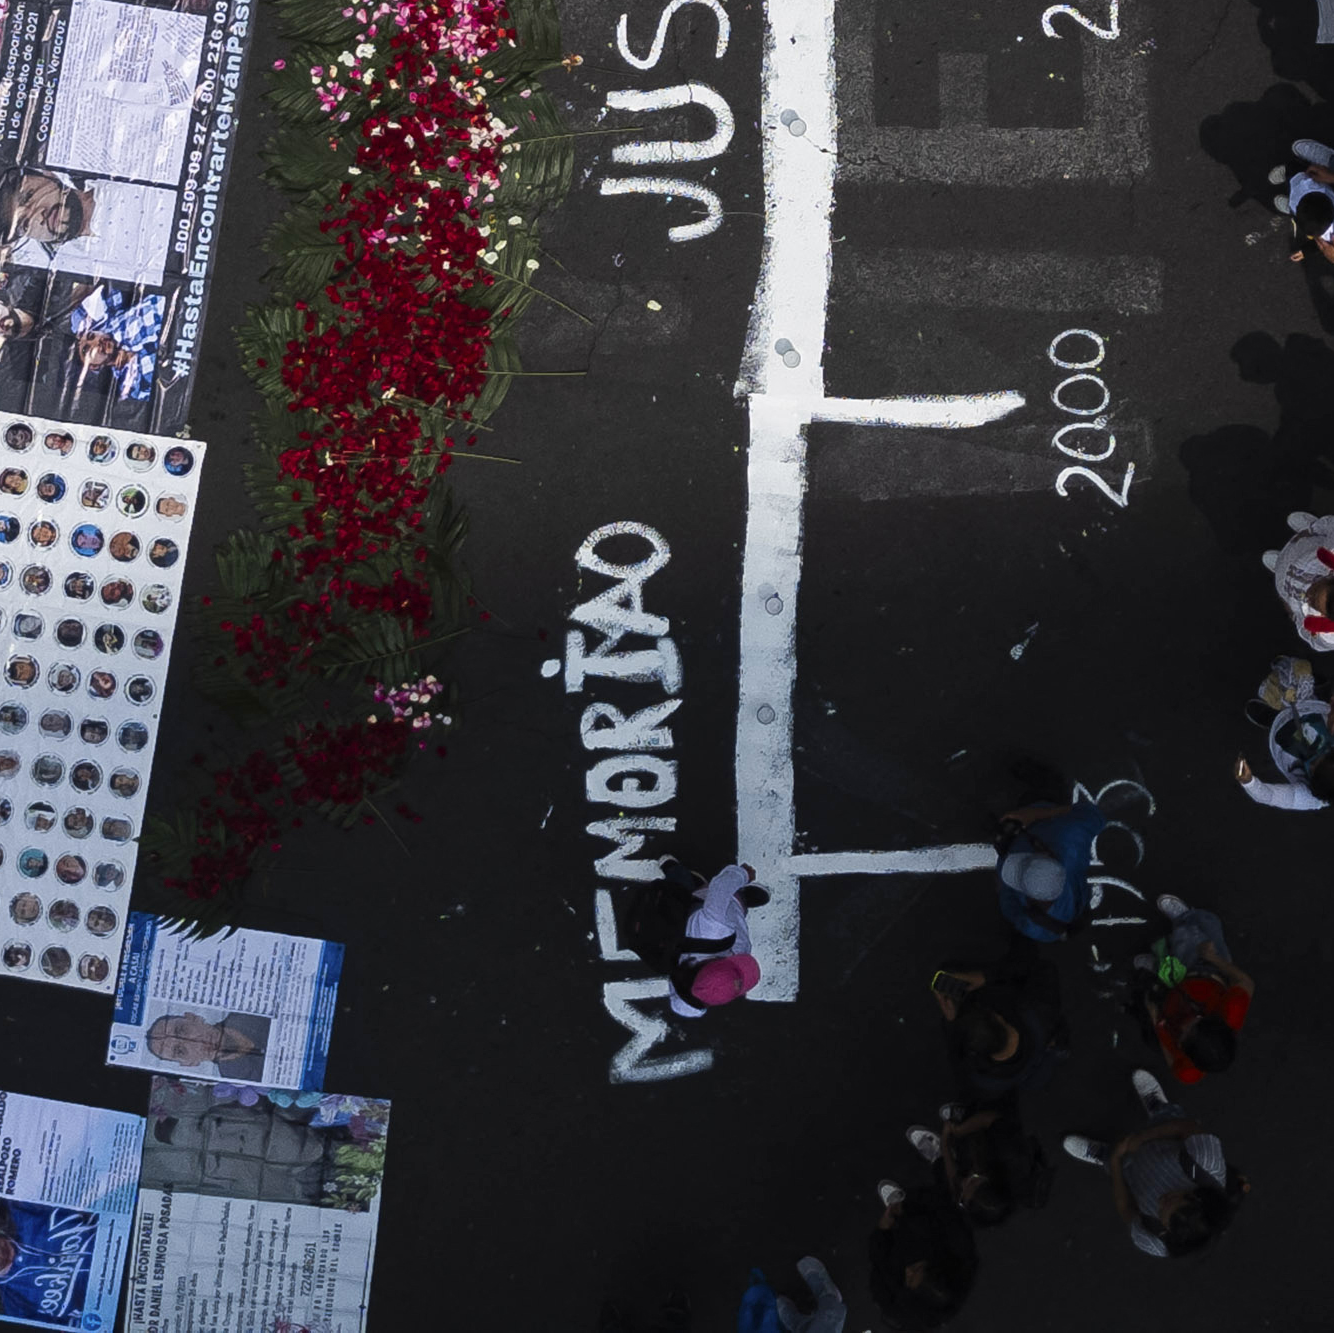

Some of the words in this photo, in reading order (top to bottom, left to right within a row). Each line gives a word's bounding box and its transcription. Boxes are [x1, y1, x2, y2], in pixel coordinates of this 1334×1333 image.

[24, 11, 38, 41] 2021
[212, 0, 228, 23] 03
[20, 43, 33, 61] de
[206, 29, 223, 63] 216
[13, 63, 29, 108] agosto
[35, 76, 57, 142] Coatepec,
[46, 19, 66, 75] Veracruz
[199, 68, 217, 103] 800
[7, 130, 18, 139] 11
[9, 111, 21, 128] de
[192, 121, 208, 145] 27
[188, 150, 203, 173] 09
[181, 178, 198, 213] 509
[175, 217, 192, 252] 800
[1049, 328, 1134, 506] 2000
[5, 1147, 21, 1195] ROMERO
[153, 1231, 169, 1281] ESPINOSA
[131, 1286, 146, 1325] ¡HASTA
[149, 1283, 163, 1318] DANIEL
